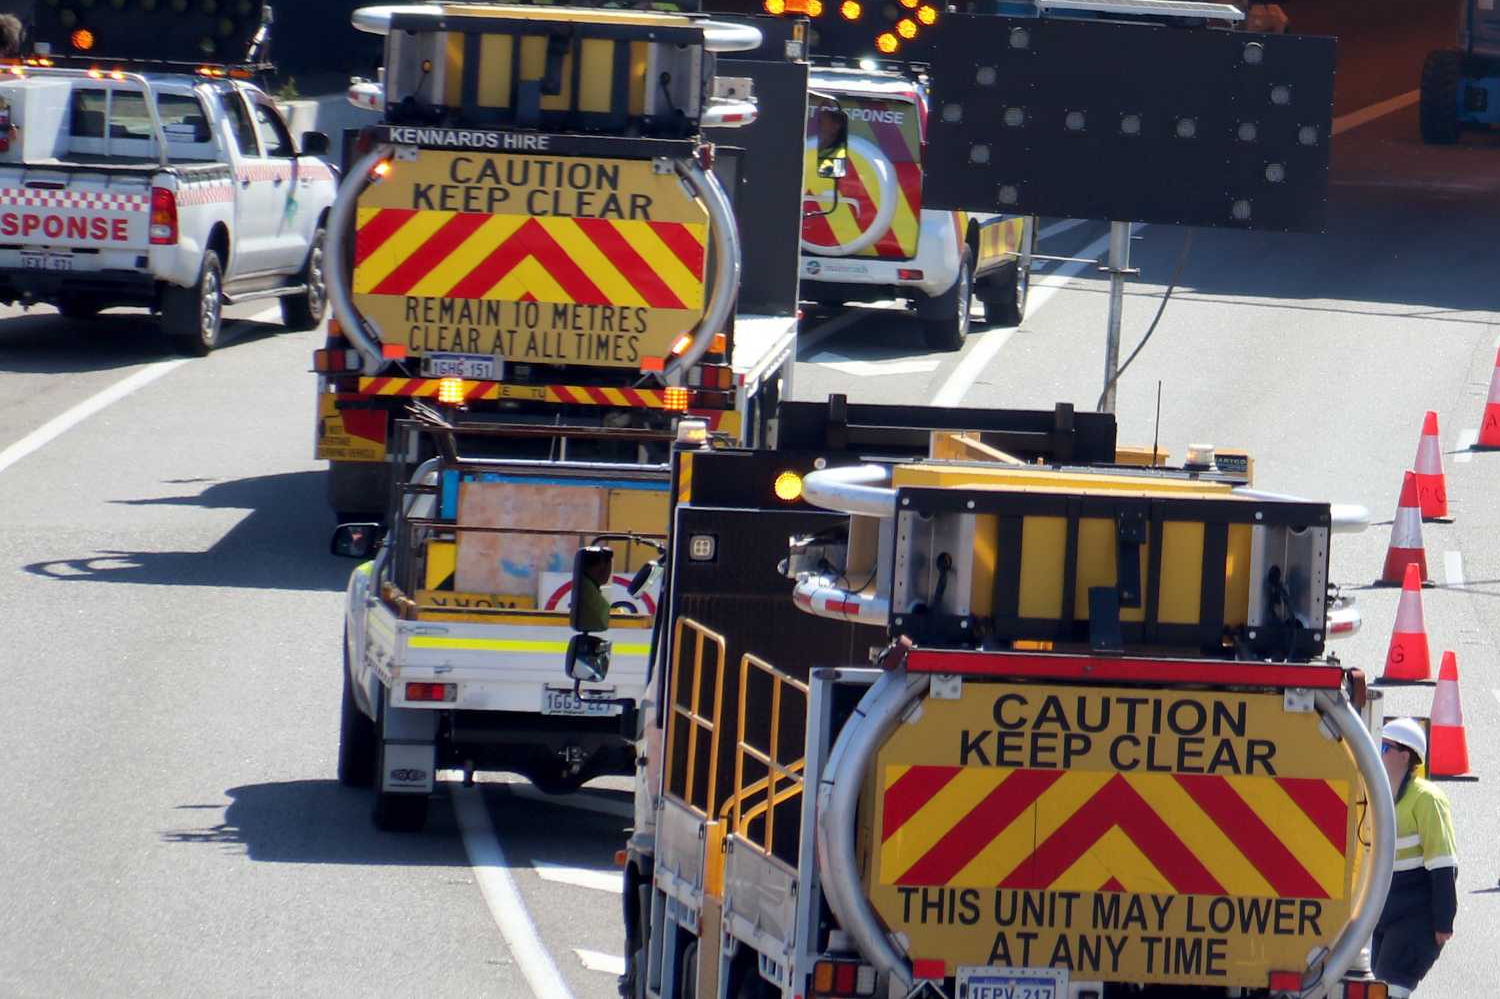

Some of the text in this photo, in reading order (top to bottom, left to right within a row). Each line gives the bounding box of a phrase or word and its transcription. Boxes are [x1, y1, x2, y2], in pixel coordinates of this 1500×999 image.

[390, 127, 550, 150] KENNARDS HIRE
[450, 157, 619, 190] CAUTION
[412, 183, 653, 220] KEEP CLEAR
[1, 213, 129, 241] SPONSE
[405, 296, 500, 327] REMAIN
[552, 303, 648, 334] METRES
[409, 325, 640, 362] CLEAR AT ALL TIMES
[992, 693, 1247, 737] CAUTION
[959, 729, 1277, 776] KEEP CLEAR
[897, 886, 1323, 936] THIS UNIT MAY LOWER
[987, 932, 1229, 976] AT ANY TIME
